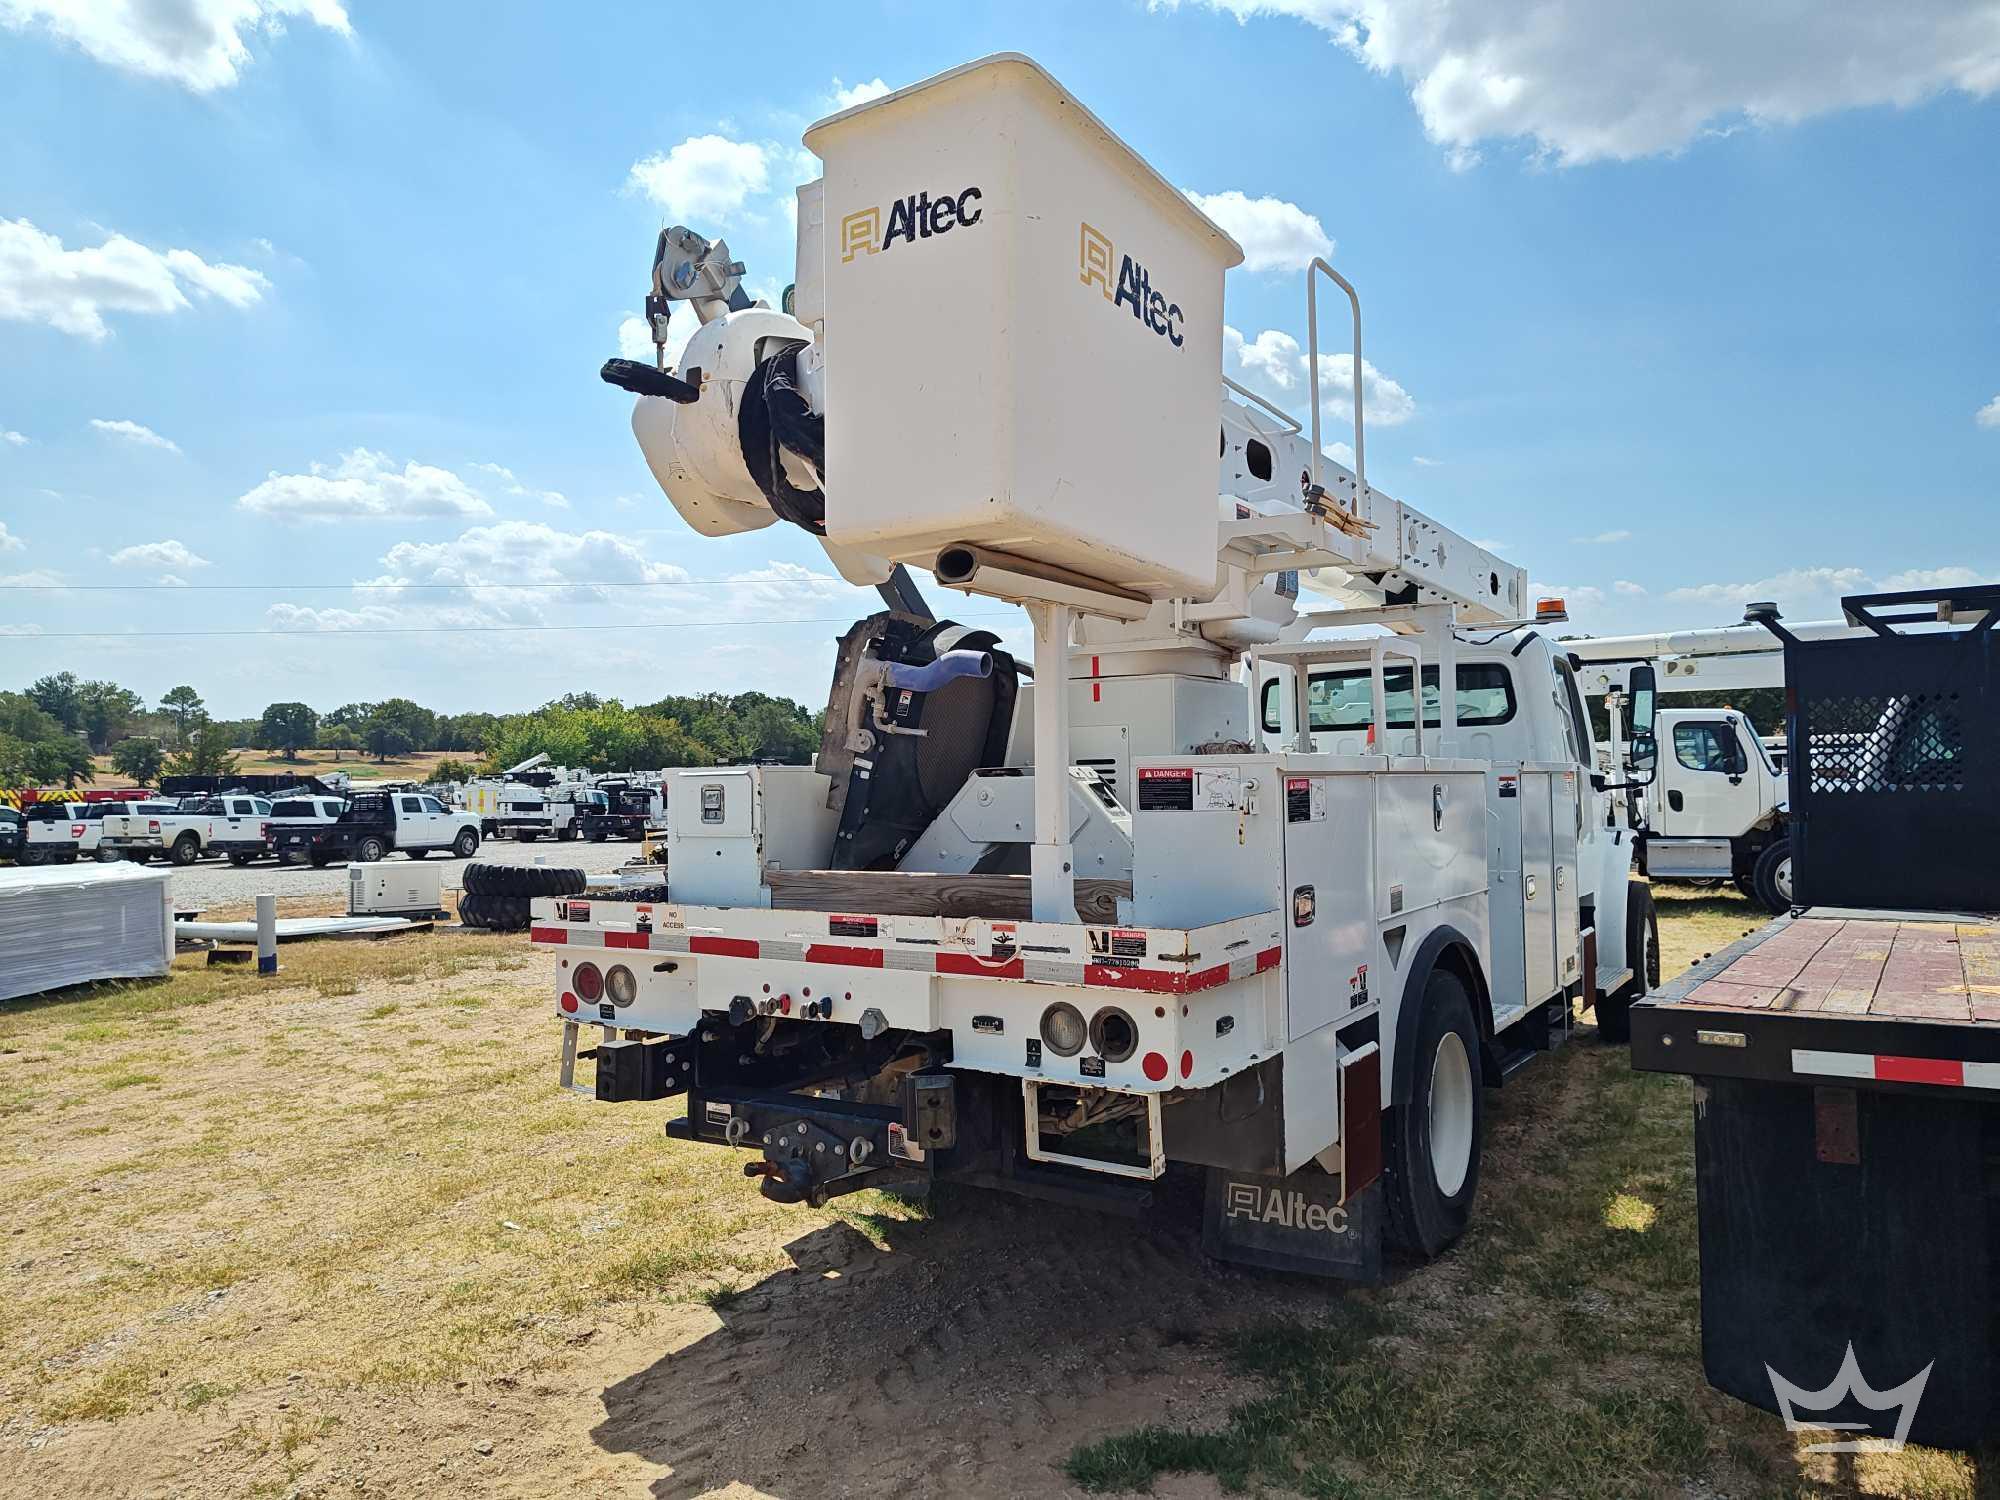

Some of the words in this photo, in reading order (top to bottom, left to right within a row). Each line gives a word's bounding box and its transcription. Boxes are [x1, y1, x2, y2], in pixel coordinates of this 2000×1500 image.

[882, 187, 982, 251] Altec
[1114, 254, 1184, 347] Altec
[1153, 770, 1187, 778] DANGER
[1262, 1188, 1348, 1234] Altec
